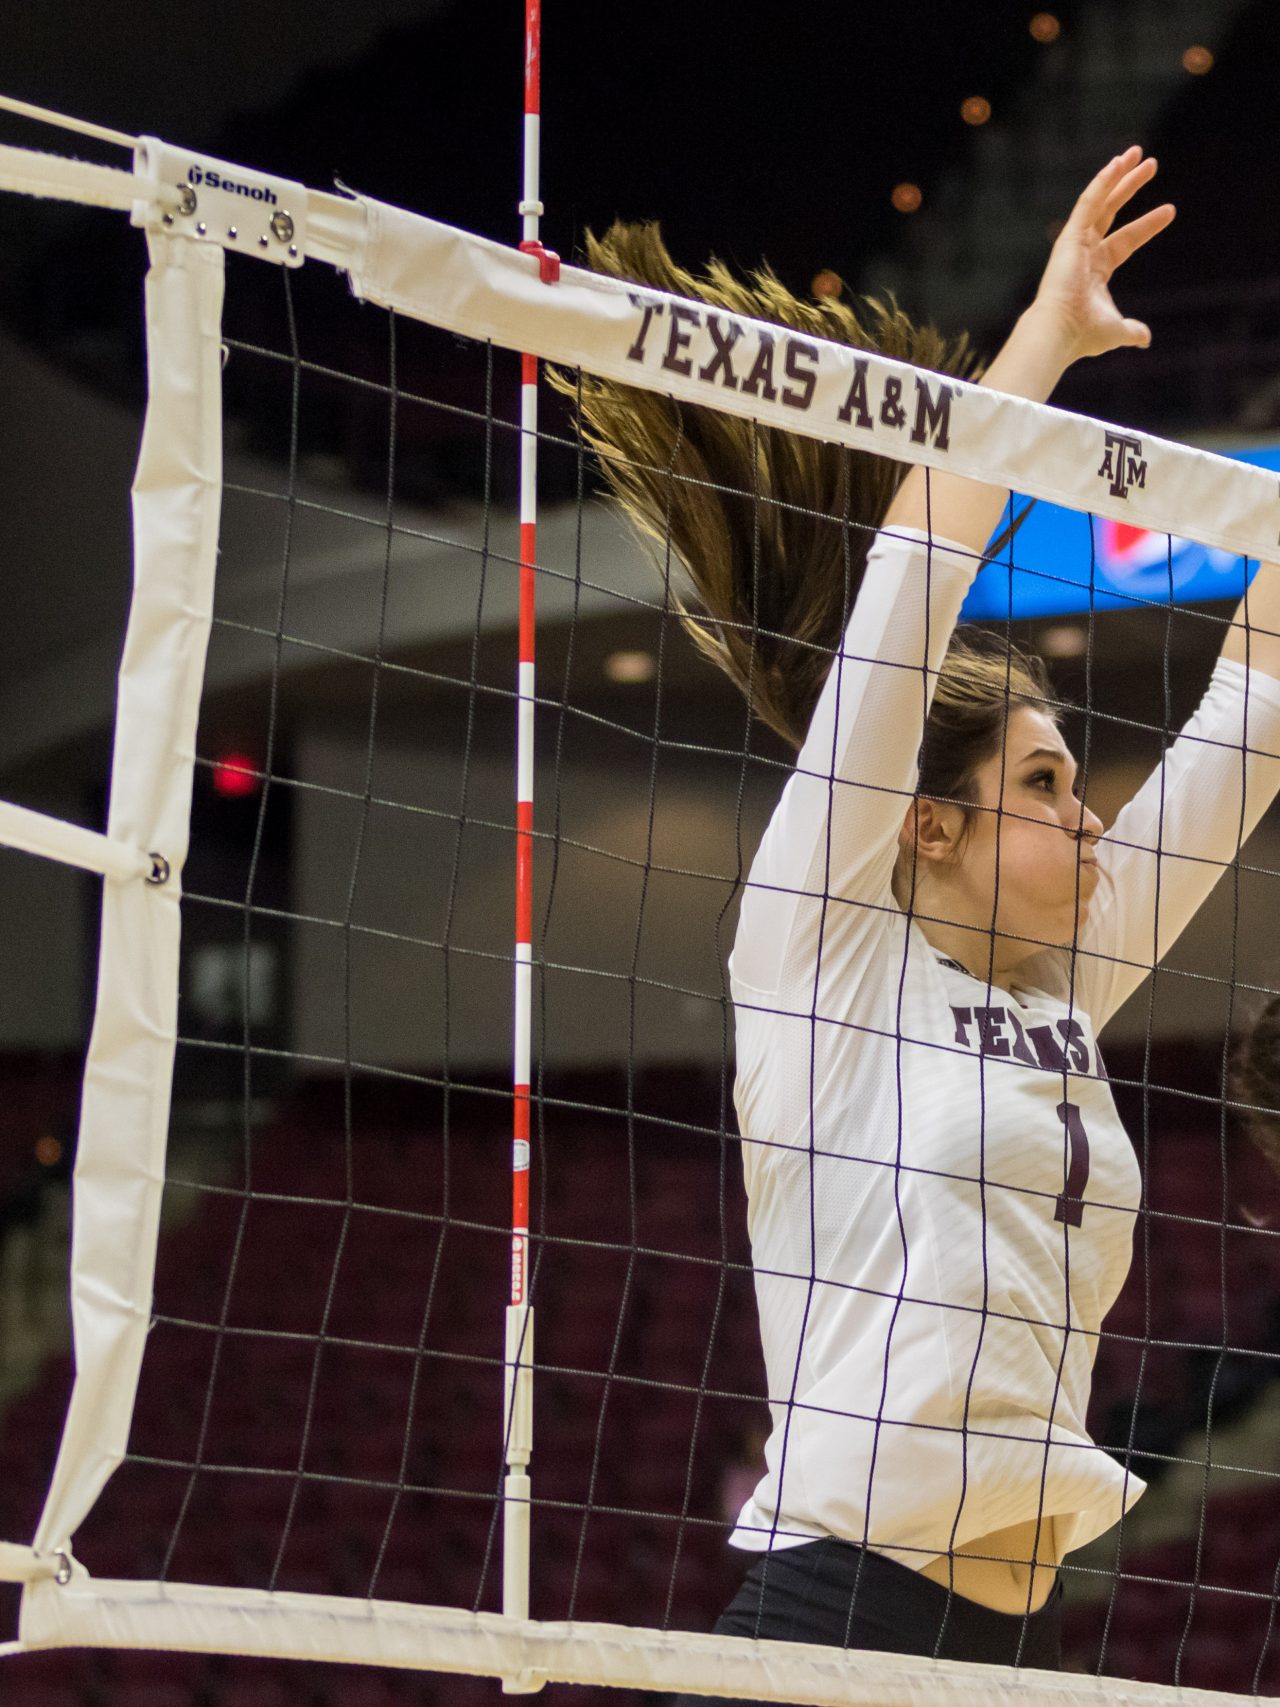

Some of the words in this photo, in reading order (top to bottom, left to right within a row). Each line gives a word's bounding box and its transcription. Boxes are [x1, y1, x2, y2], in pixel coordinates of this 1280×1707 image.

[205, 171, 278, 205] Senoh
[627, 293, 819, 411] TEXAS
[837, 358, 953, 451] A&M
[1054, 1102, 1090, 1228] 1
